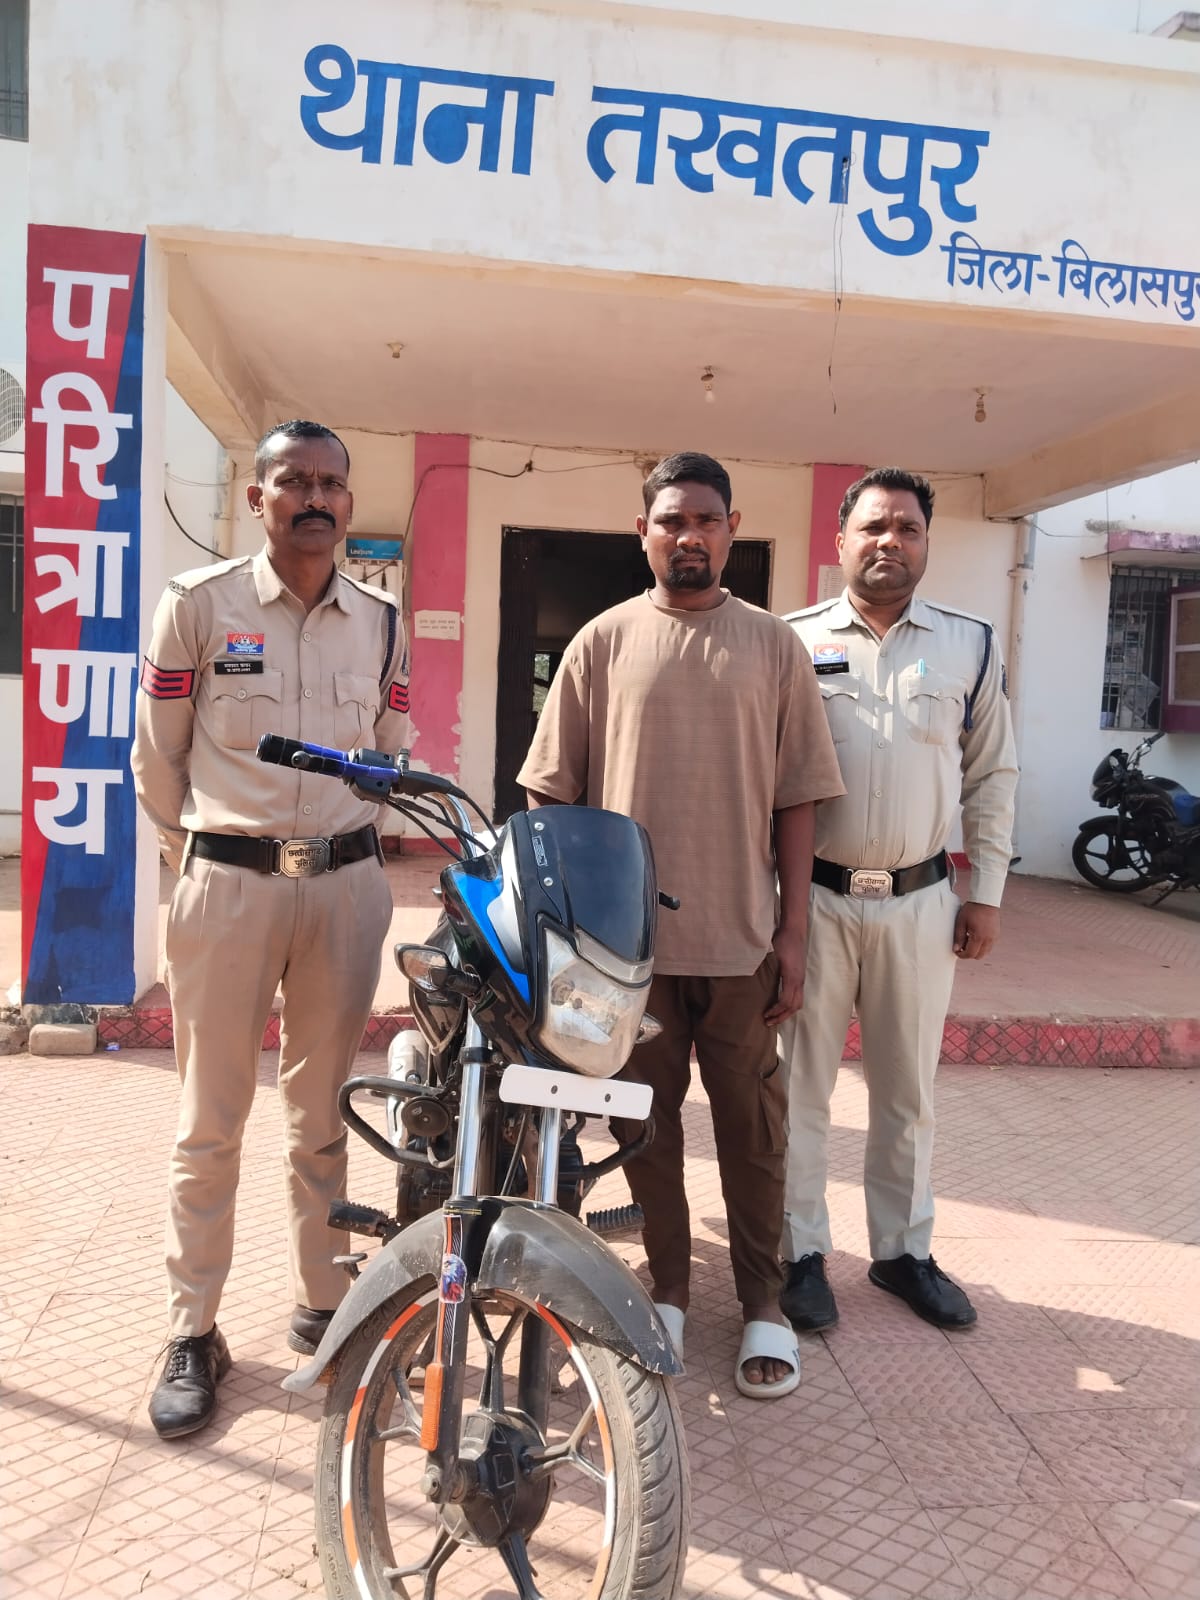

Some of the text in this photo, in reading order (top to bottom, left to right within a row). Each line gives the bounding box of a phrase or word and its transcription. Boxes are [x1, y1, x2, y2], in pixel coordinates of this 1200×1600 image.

[300, 43, 990, 257] थाना तखतपुर
[939, 230, 1200, 322] जिला-बिलासपु
